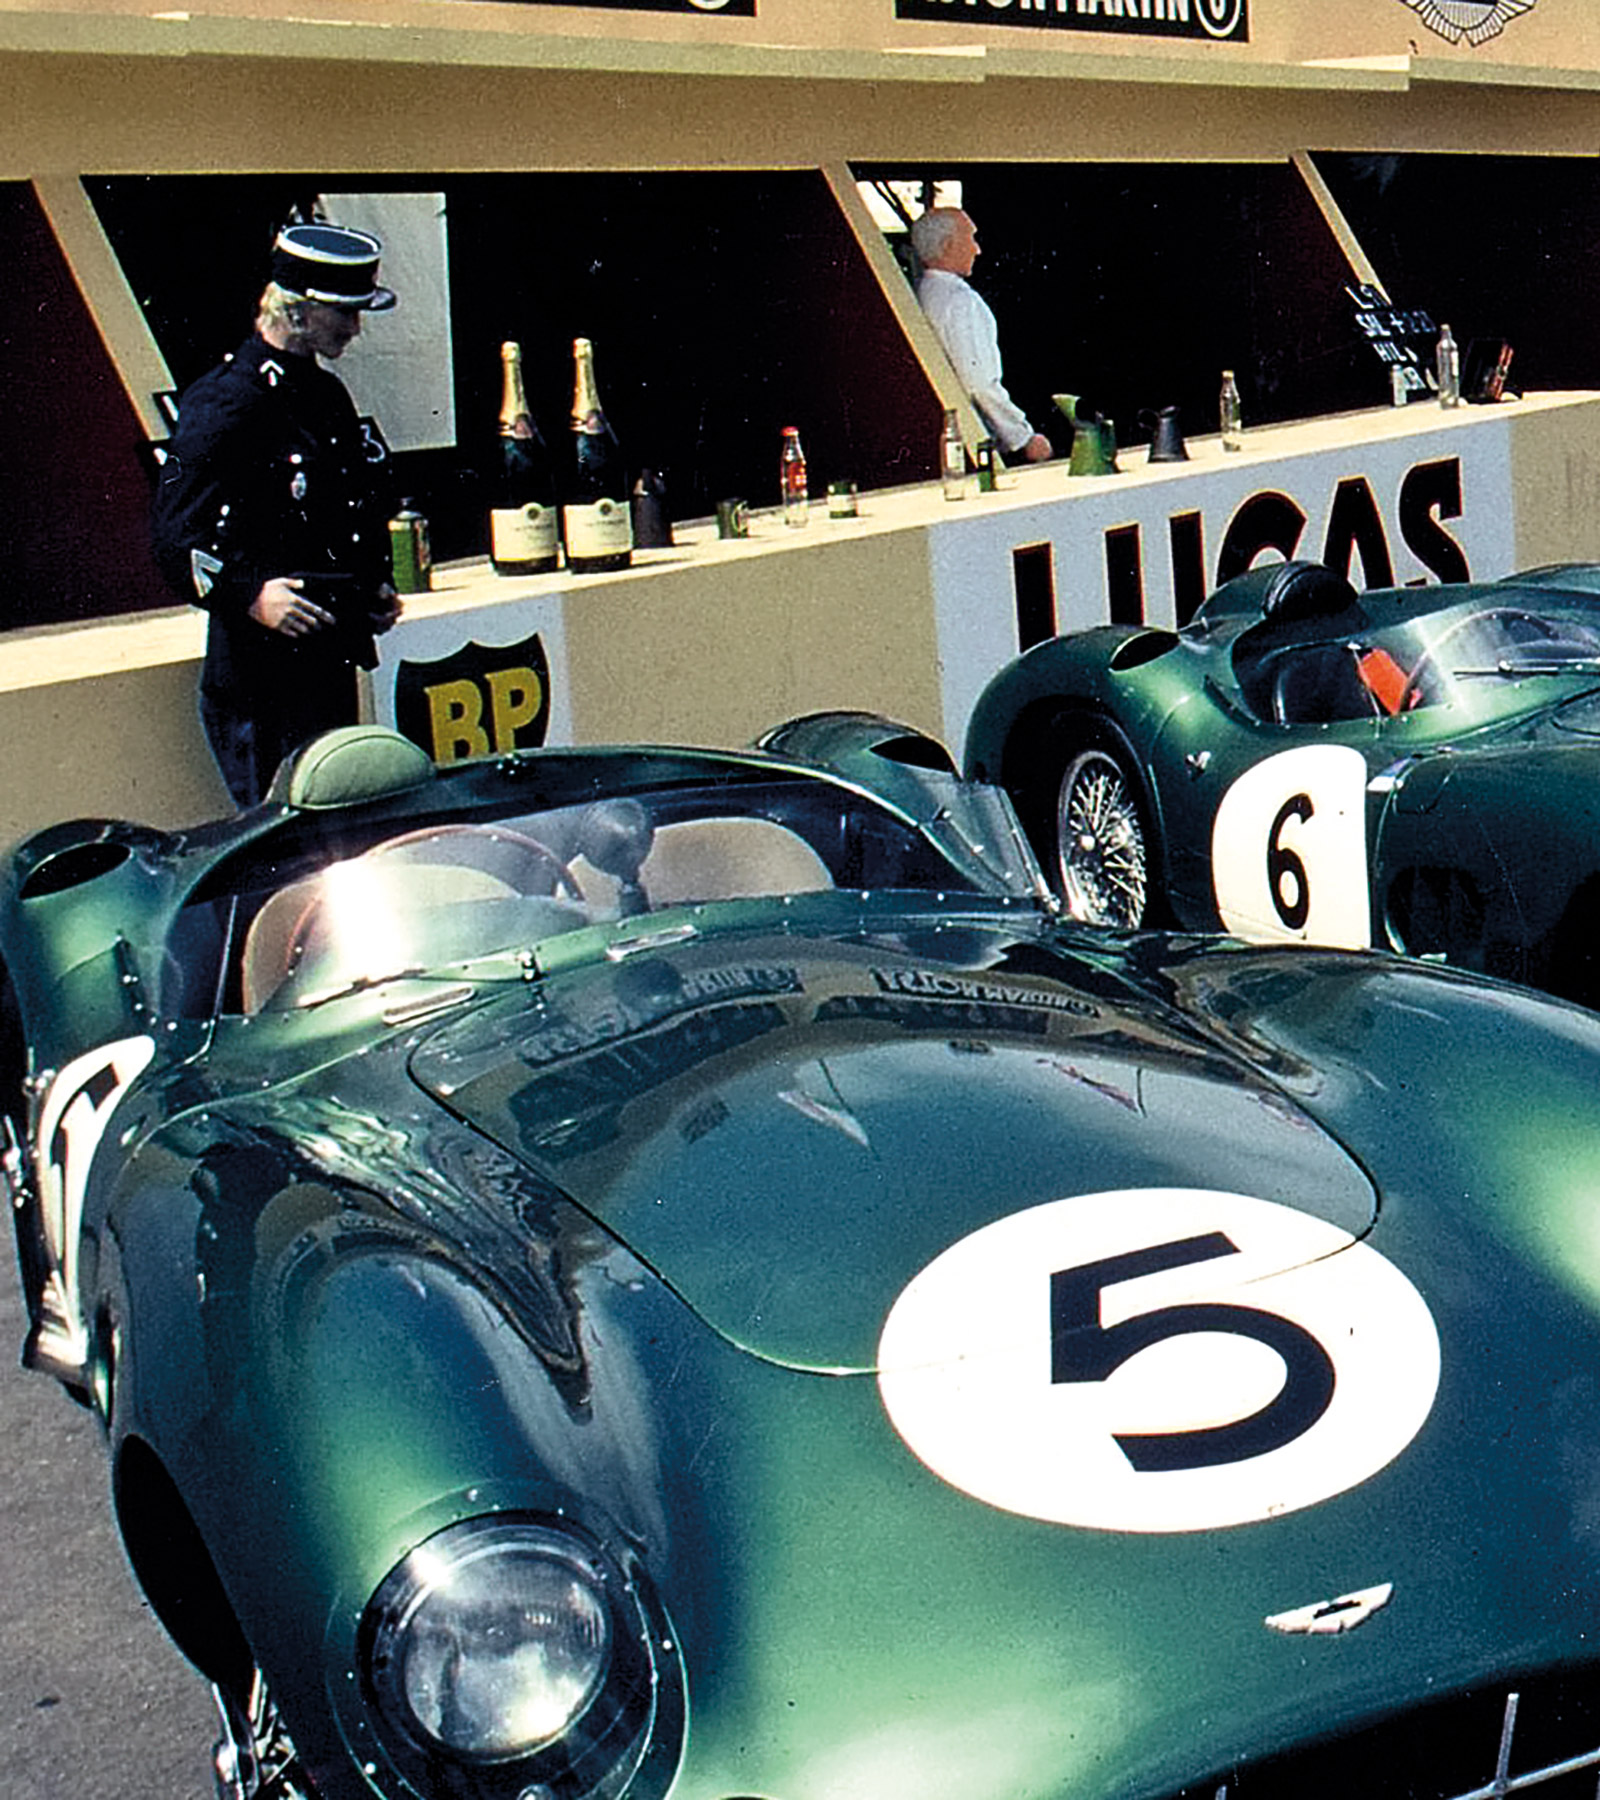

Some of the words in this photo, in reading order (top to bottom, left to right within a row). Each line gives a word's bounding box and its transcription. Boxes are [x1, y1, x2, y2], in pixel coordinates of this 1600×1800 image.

[423, 667, 541, 768] BP
[1267, 792, 1315, 930] 6
[1050, 1231, 1337, 1472] 5
